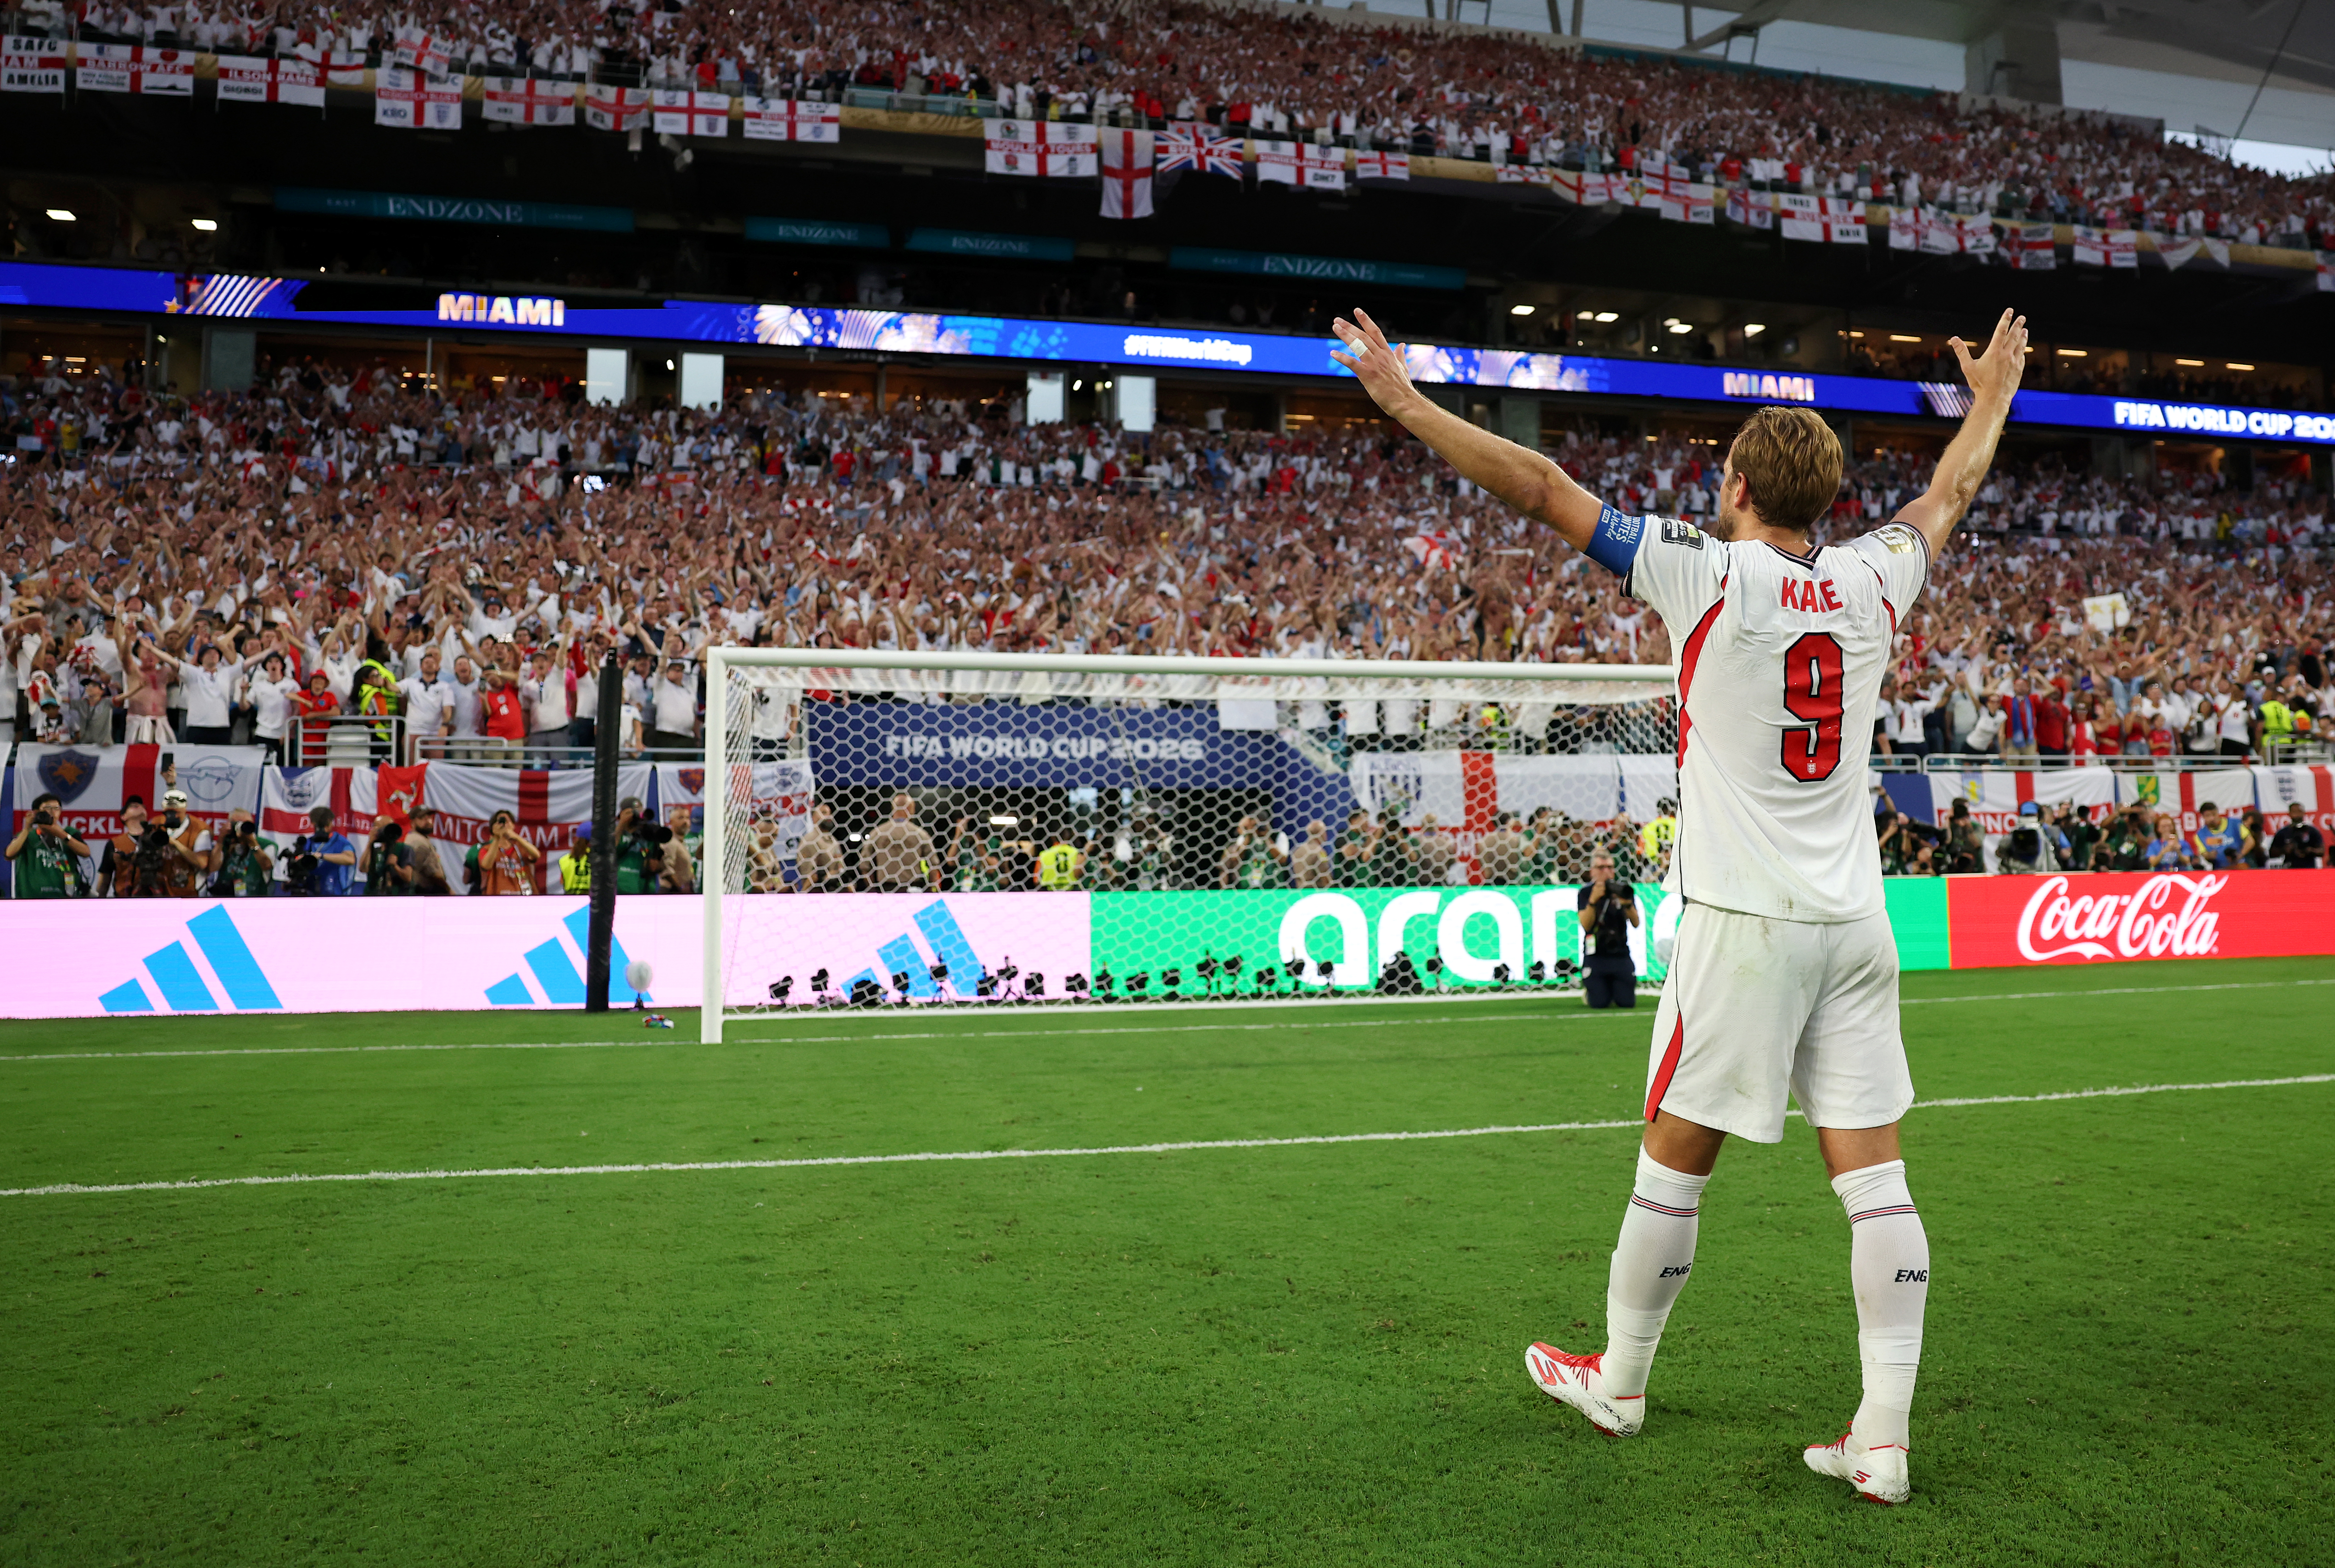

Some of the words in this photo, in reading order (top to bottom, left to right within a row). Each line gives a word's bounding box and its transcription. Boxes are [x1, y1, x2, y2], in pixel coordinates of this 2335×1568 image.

[86, 58, 150, 73] BARROW
[156, 64, 185, 74] AFC
[1168, 144, 1207, 157] BURY
[387, 196, 523, 223] ENDZONE
[778, 225, 858, 241] ENDZONE
[952, 236, 1029, 253] ENDZONE
[1262, 255, 1376, 281] ENDZONE
[438, 293, 564, 327] MIAMI
[1723, 372, 1815, 402] MIAMI
[2114, 402, 2166, 428] FIFA
[2165, 404, 2242, 433] WORLD
[2247, 411, 2293, 436] CUP
[2294, 414, 2335, 440] 20
[1602, 508, 1610, 523] FIFA
[1615, 513, 1632, 543] UNITES
[1626, 516, 1642, 544] FOOTBALL
[1781, 576, 1843, 613] KAE
[1780, 631, 1845, 783] 9
[885, 736, 944, 758] FIFA
[948, 737, 1048, 759] WORLD
[1051, 737, 1107, 759] CUP
[1111, 739, 1205, 760] 2026
[433, 812, 559, 849] MITCAM
[2268, 814, 2316, 830] YOK
[2017, 873, 2229, 961] Coca-Cola
[1659, 1262, 1692, 1278] ENG
[1894, 1269, 1927, 1283] ENG
